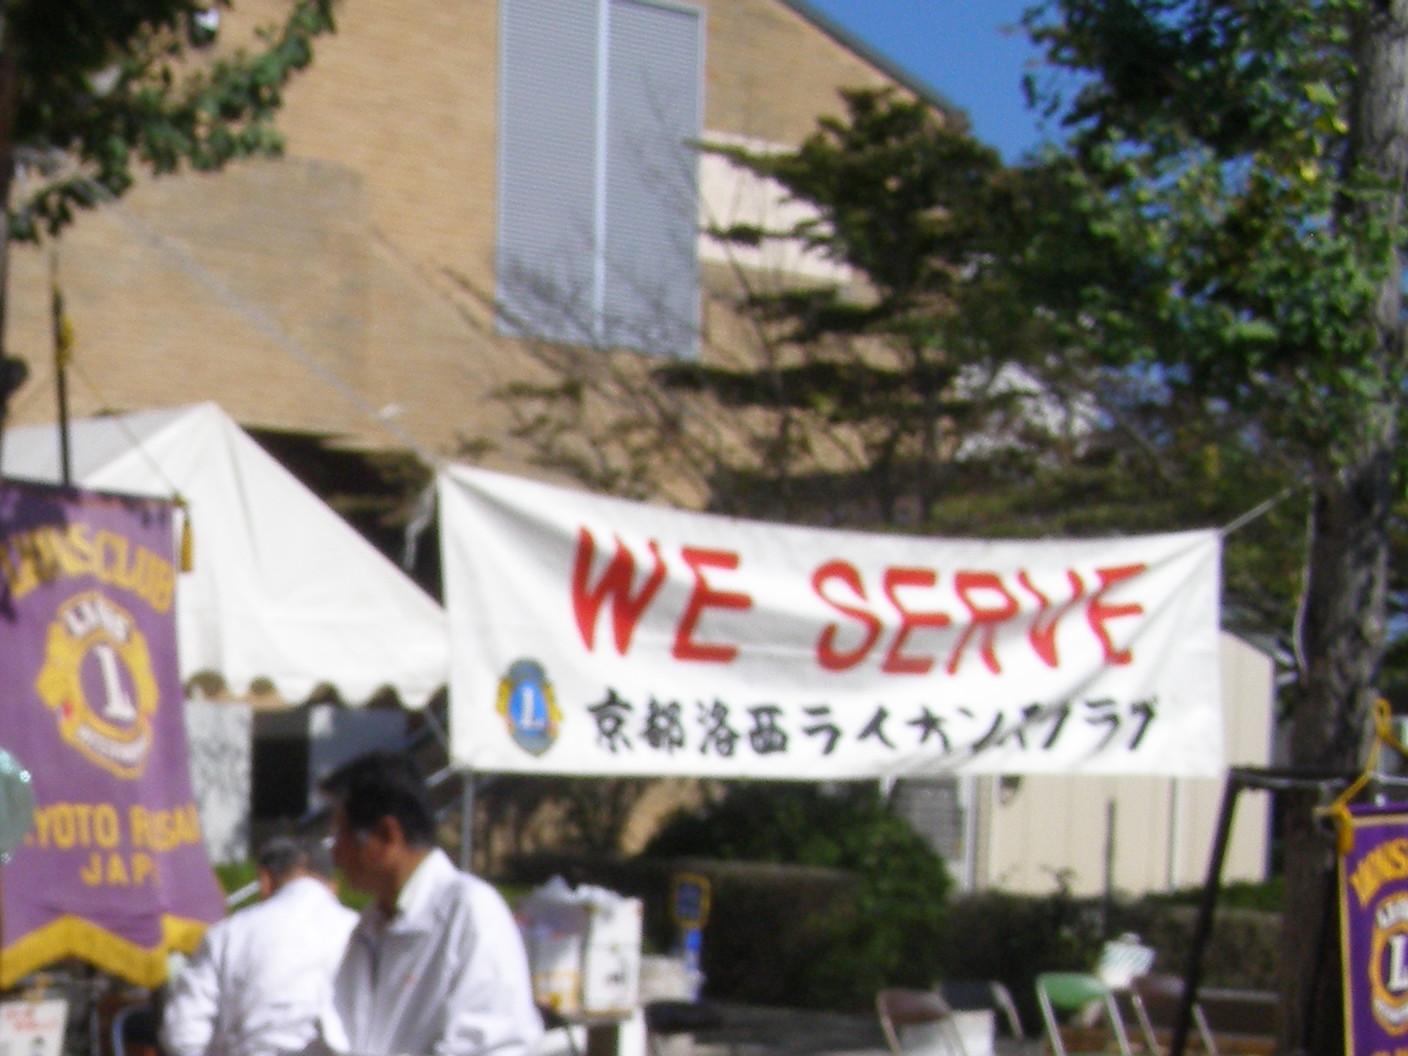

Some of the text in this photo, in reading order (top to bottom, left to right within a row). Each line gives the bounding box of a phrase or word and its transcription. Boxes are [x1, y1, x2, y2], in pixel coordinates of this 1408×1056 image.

[572, 527, 1148, 675] WE SERVE
[24, 802, 120, 849] YOTO
